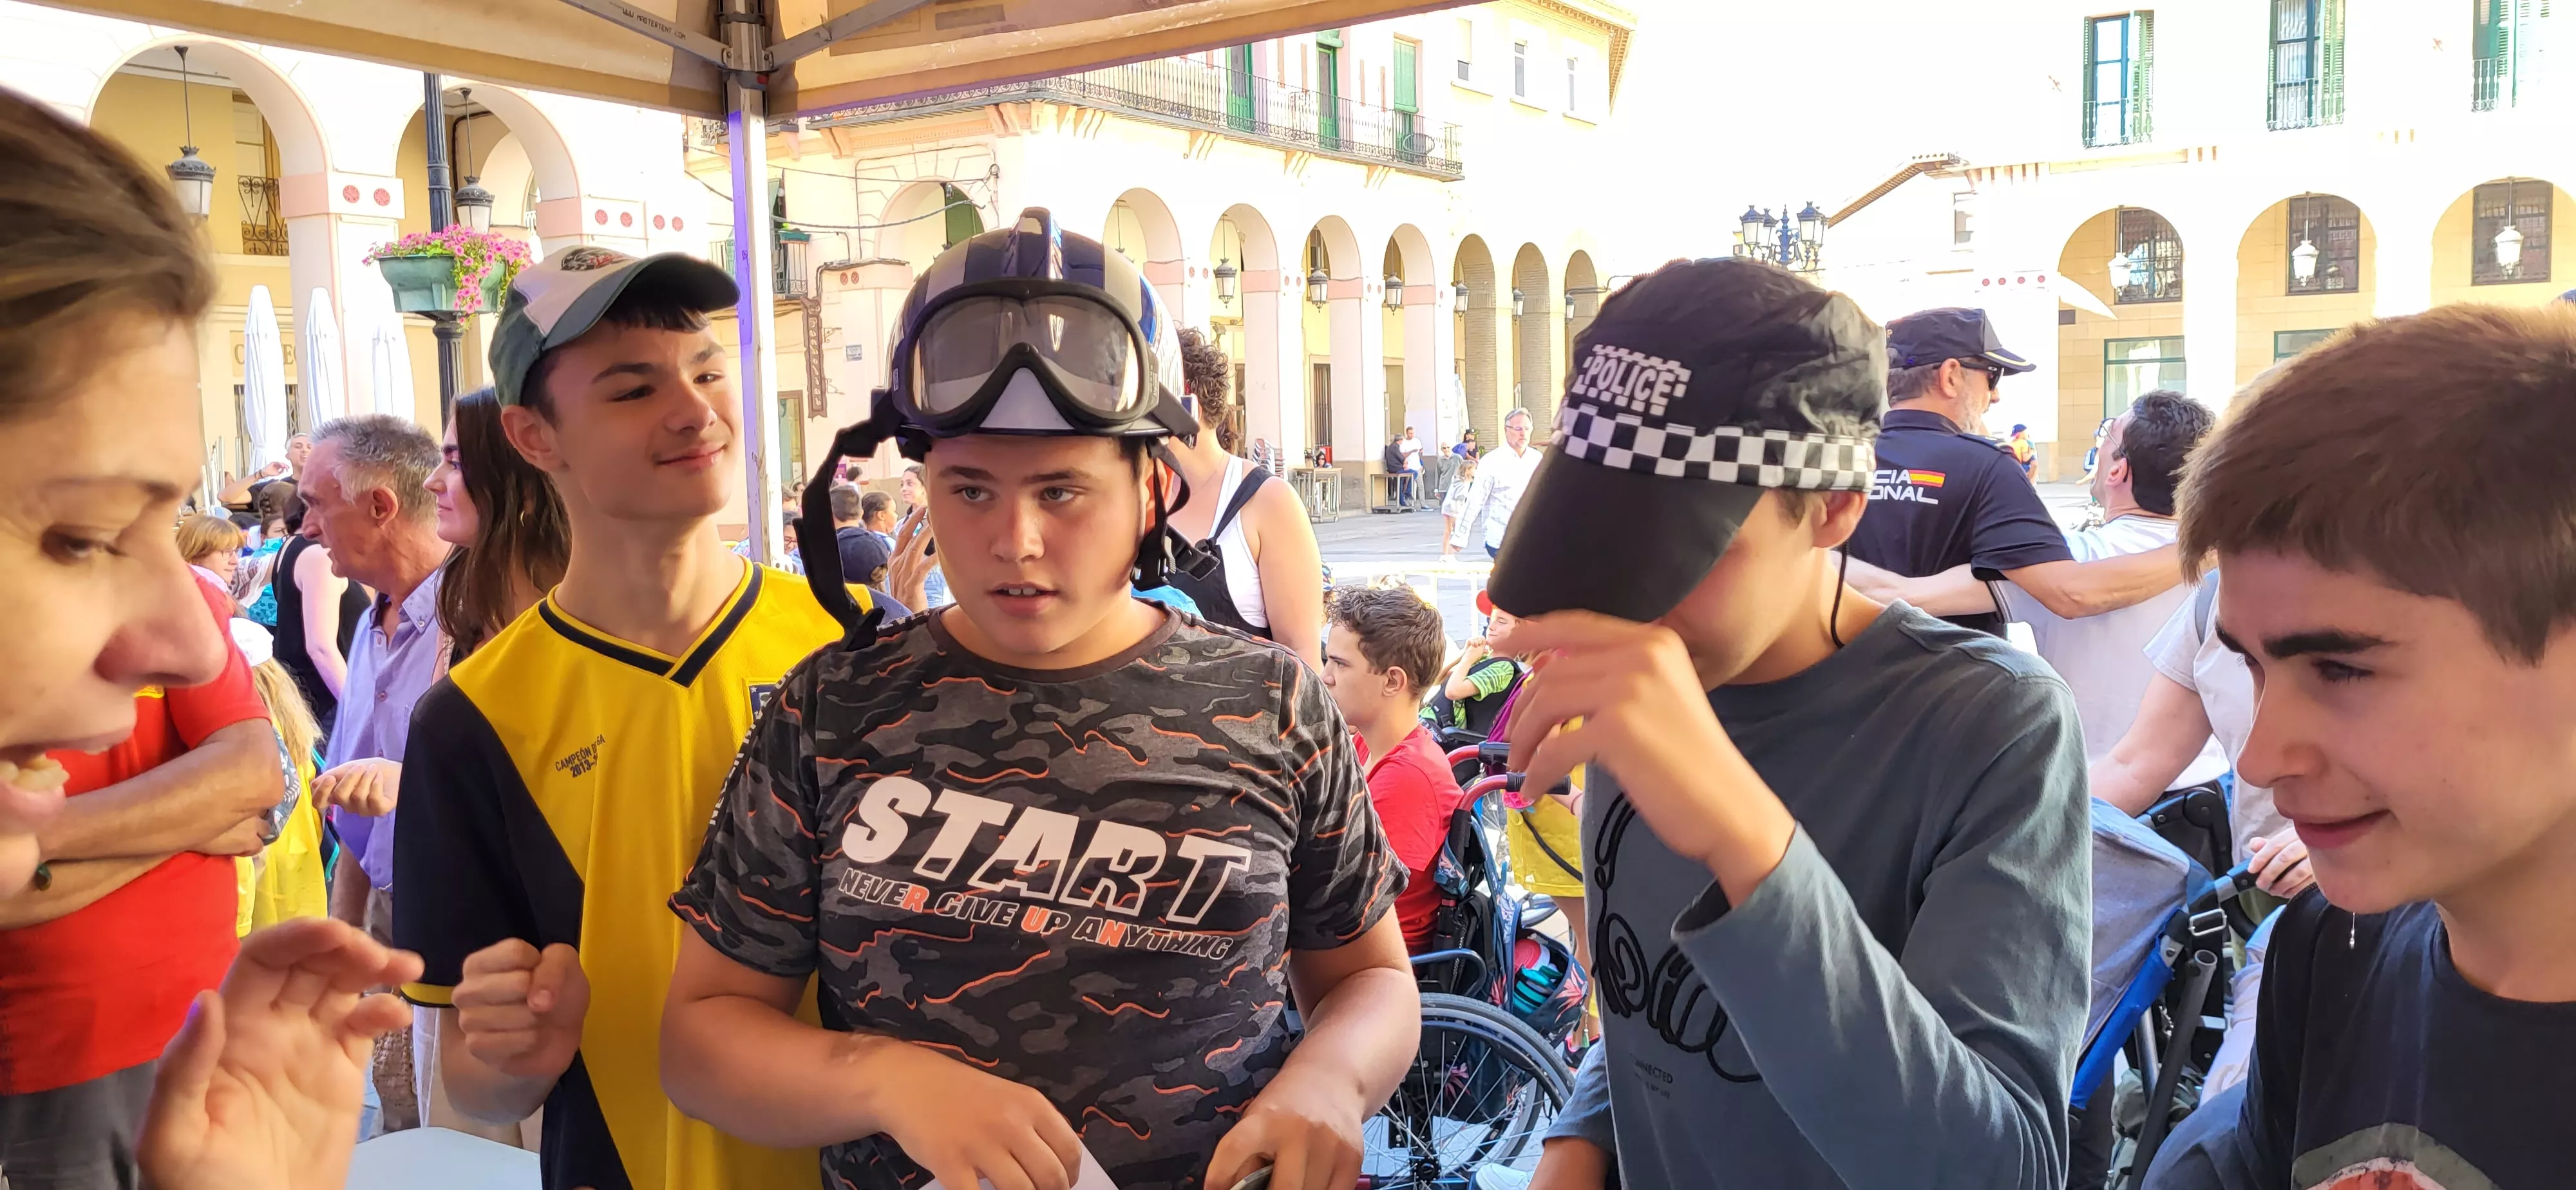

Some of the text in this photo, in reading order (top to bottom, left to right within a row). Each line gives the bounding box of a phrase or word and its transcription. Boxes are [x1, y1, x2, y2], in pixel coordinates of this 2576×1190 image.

[1584, 355, 1676, 406] POLICE
[1868, 485, 1939, 505] ONAL
[1873, 469, 1912, 484] CIA
[555, 746, 592, 771] CAMPEÓN
[841, 776, 1252, 925] START
[838, 868, 1235, 960] NEVER GIVE UP ANYTHING
